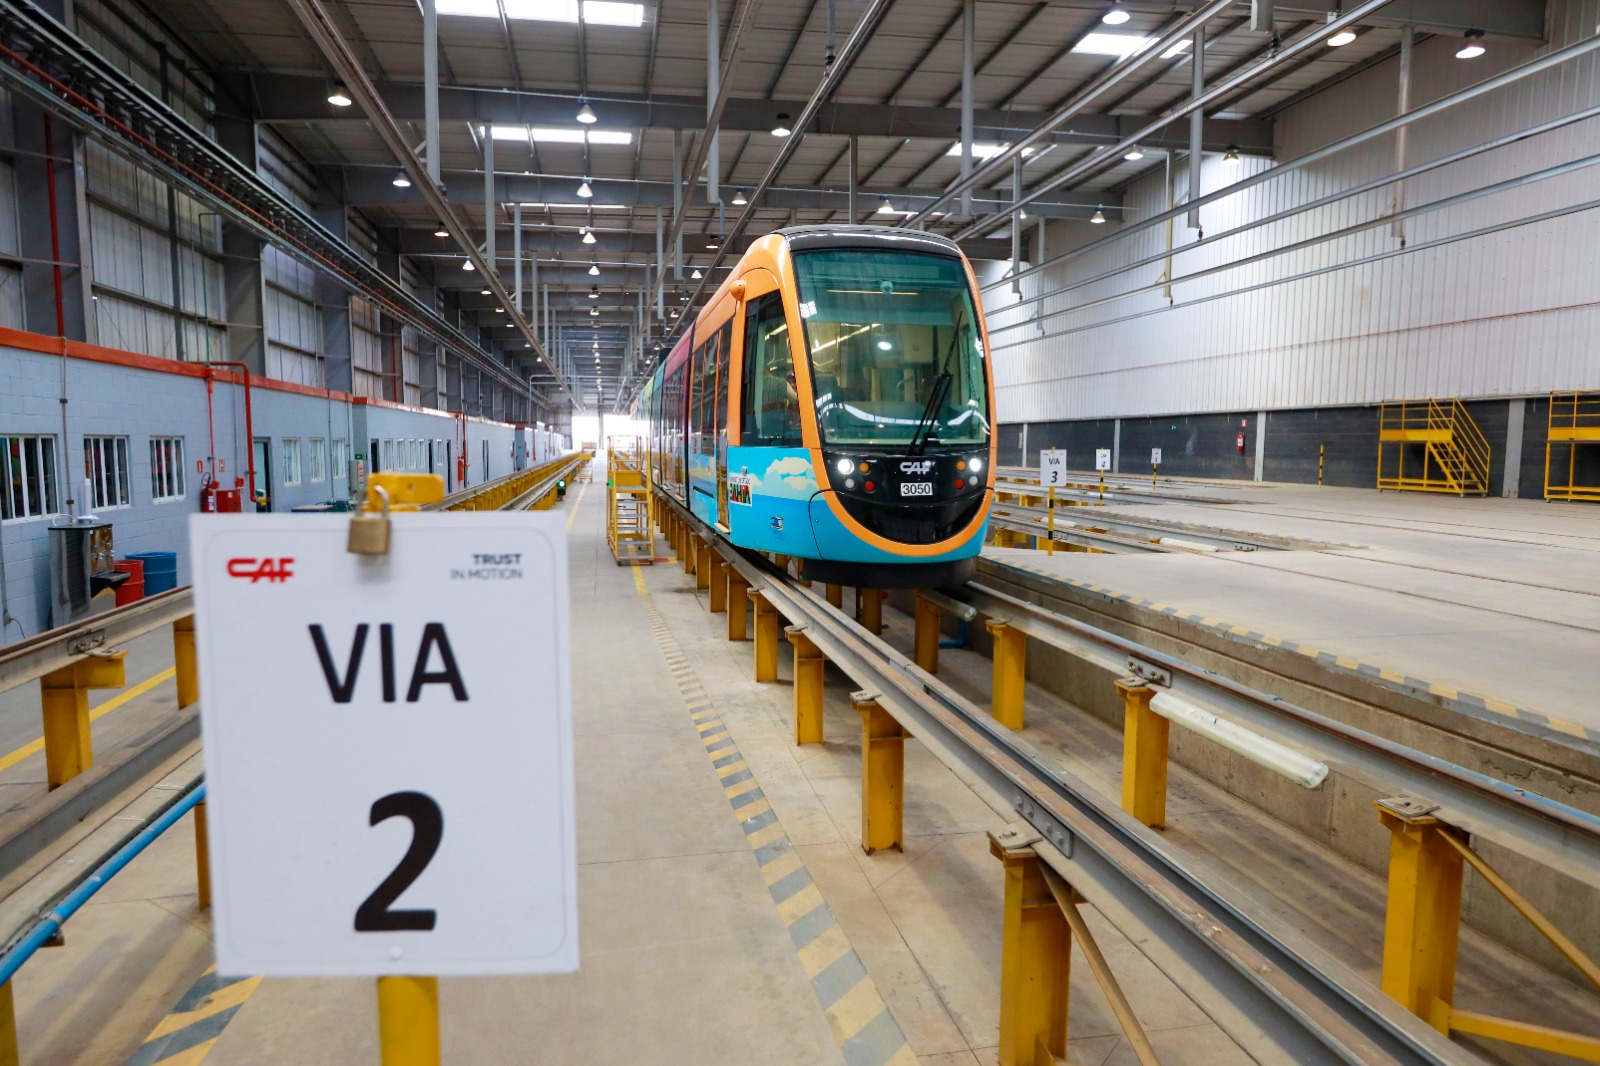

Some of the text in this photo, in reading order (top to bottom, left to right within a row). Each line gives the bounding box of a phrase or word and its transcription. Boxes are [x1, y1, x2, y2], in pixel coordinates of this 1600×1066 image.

[1050, 470, 1058, 483] 3
[902, 484, 931, 495] 3050
[472, 553, 522, 566] TRUST
[226, 557, 294, 583] CAF
[450, 568, 523, 580] IN MOTION
[308, 622, 469, 704] VIA
[353, 790, 444, 933] 2
